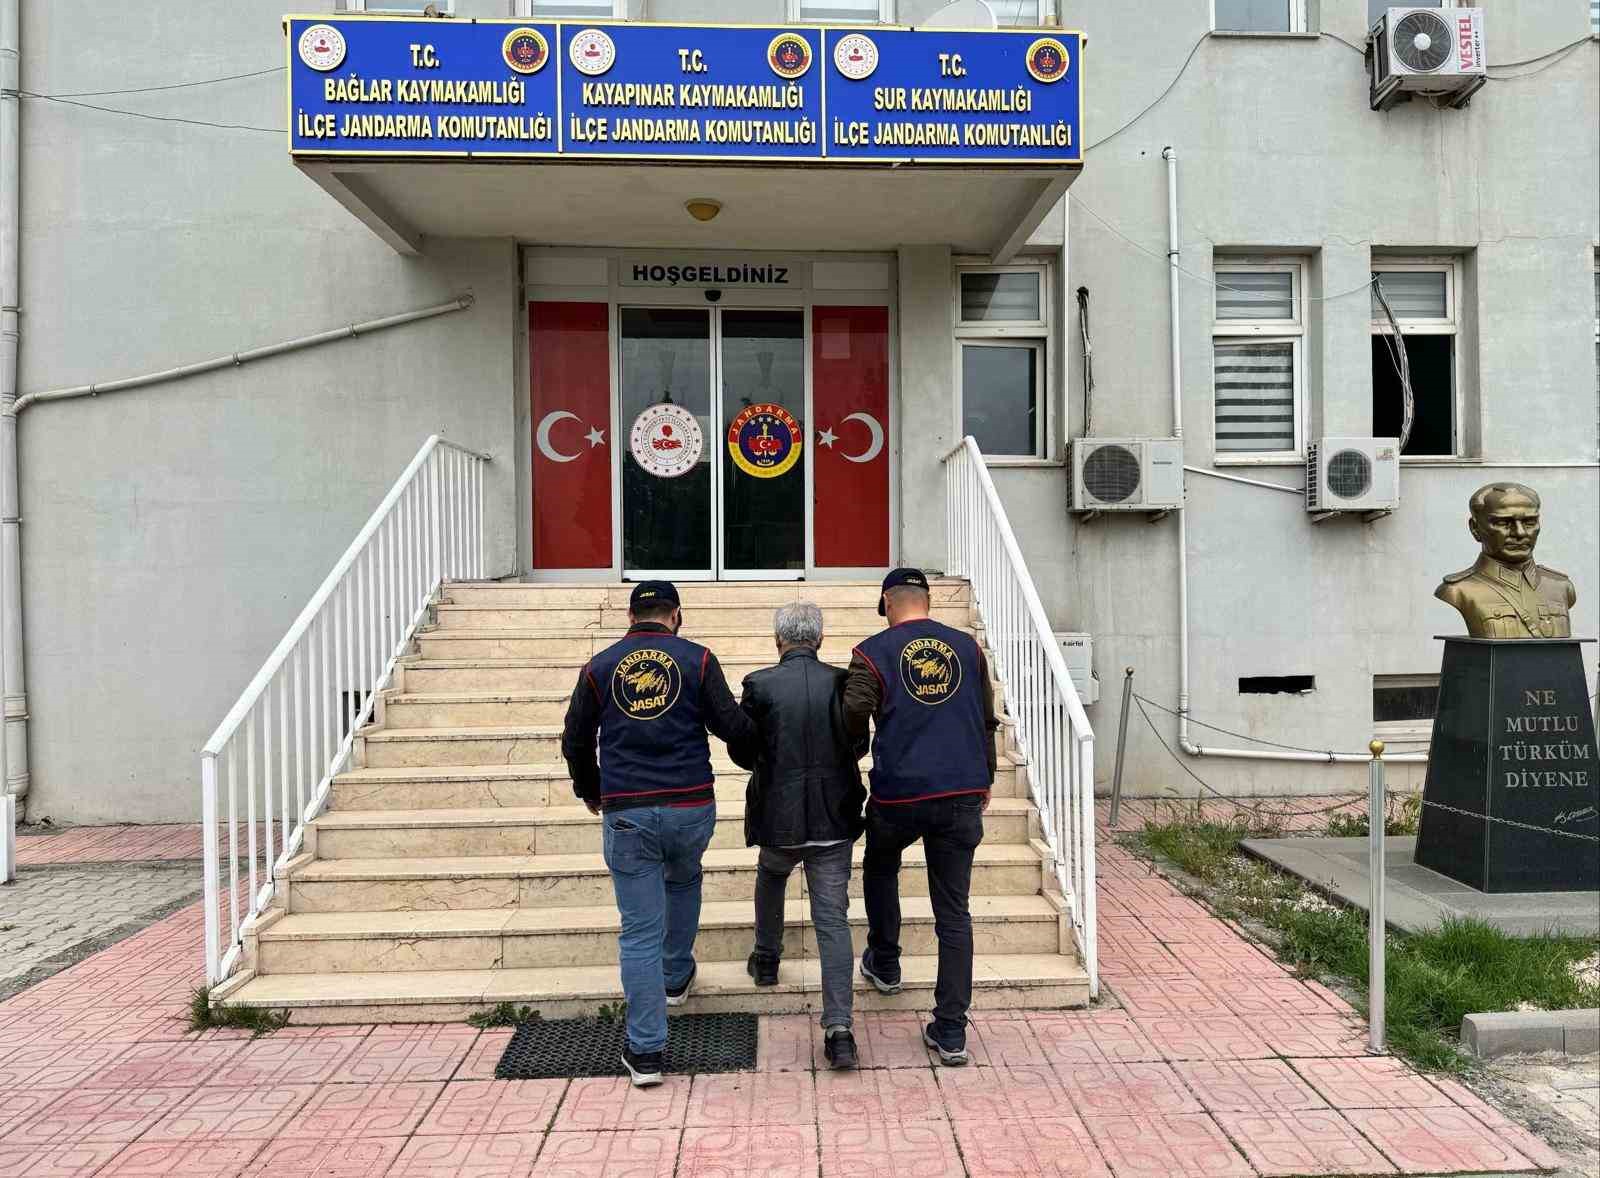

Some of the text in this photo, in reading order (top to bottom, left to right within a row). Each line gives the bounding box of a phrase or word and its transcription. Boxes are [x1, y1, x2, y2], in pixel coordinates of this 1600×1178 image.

[1458, 14, 1473, 70] VESTEL
[410, 44, 440, 68] T.C.
[678, 49, 708, 73] T.C.
[938, 53, 968, 77] T.C.
[324, 73, 526, 105] BAĞLAR KAYMAKAMLIĞI
[582, 80, 804, 109] KAYAPINAR KAYMAKAMLIĞI
[874, 84, 1032, 113] SUR KAYMAKAMLIĞI
[298, 109, 553, 141] İLÇE JANDARMA KOMUTANLIĞI
[570, 113, 817, 145] İLÇE JANDARMA KOMUTANLIĞI
[834, 116, 1073, 148] İLÇE JANDARMA KOMUTANLIĞI
[632, 263, 790, 286] HOŞGELDİNİZ
[732, 406, 799, 435] JANDARMA
[902, 640, 954, 661] JANDARMA
[616, 650, 674, 678] JANDARMA
[915, 682, 949, 696] JASAT
[1525, 690, 1557, 706] NE
[629, 695, 667, 712] JASAT
[1506, 716, 1579, 733] MUTLU
[1499, 740, 1591, 761] TÜRKÜM
[1505, 768, 1589, 788] DİYENE
